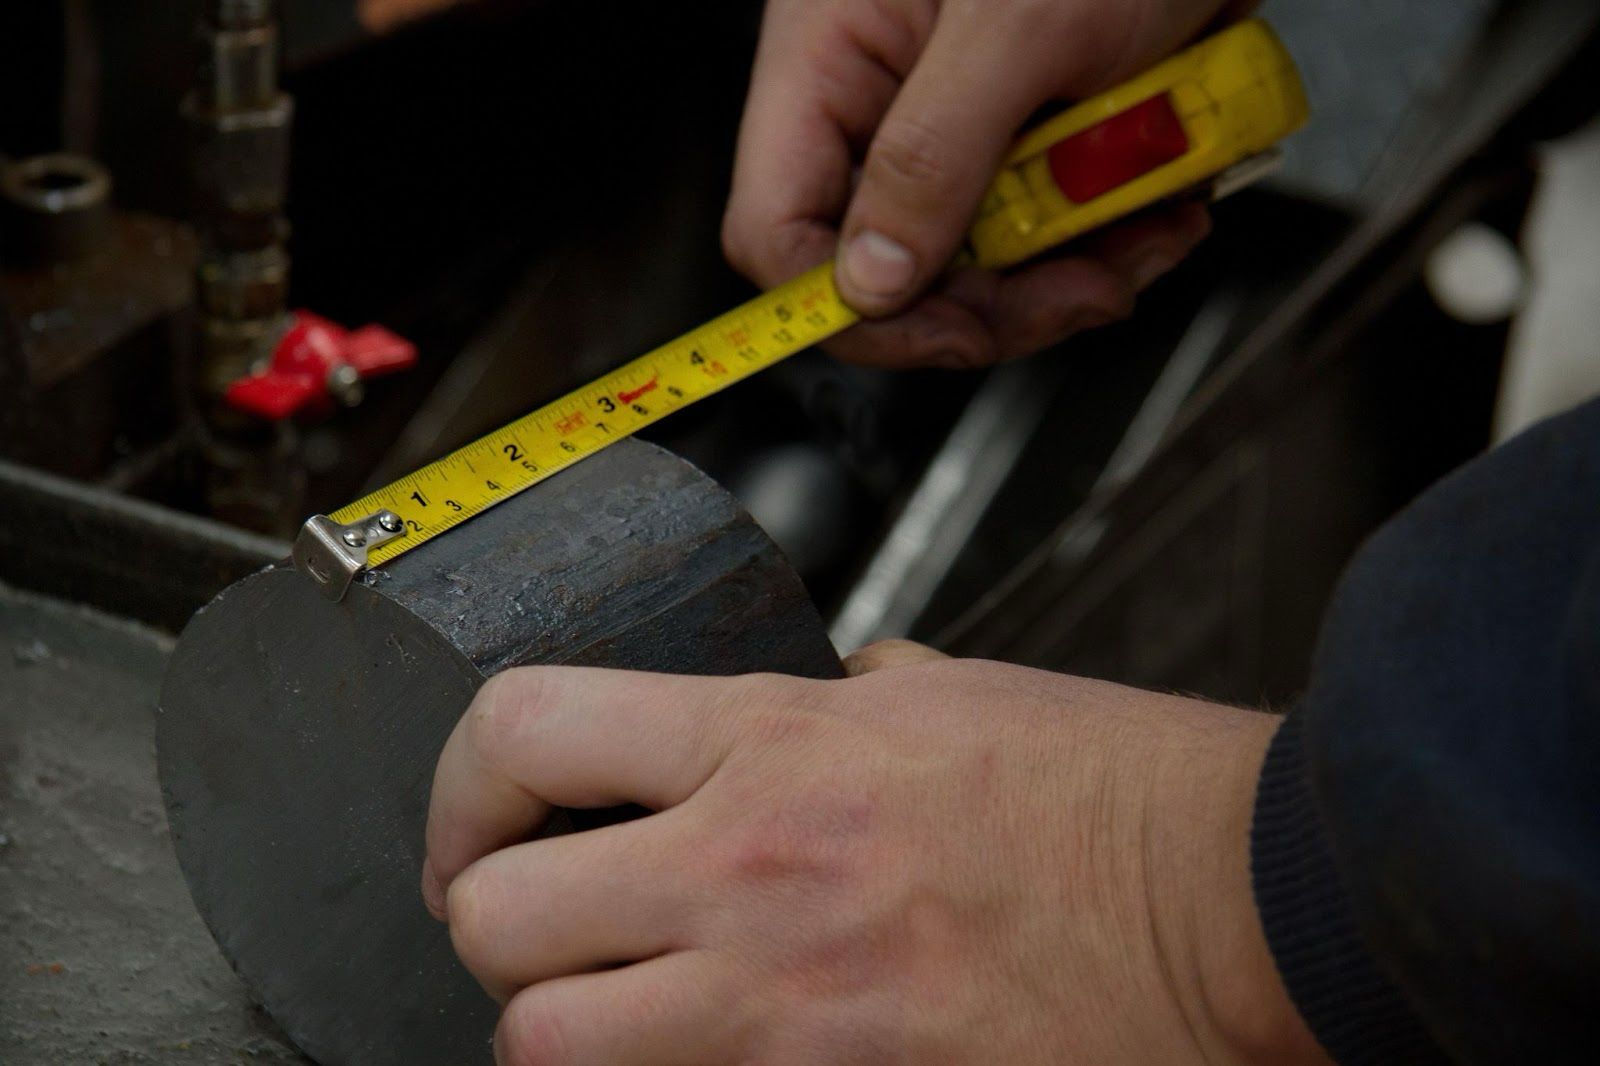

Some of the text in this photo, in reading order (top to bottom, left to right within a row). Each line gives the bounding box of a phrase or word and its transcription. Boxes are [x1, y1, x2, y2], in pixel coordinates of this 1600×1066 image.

[407, 519, 424, 533] 2
[446, 500, 462, 512] 3
[486, 480, 501, 492] 4
[522, 460, 537, 473] 5
[560, 441, 575, 453] 6
[595, 422, 610, 434] 7
[631, 404, 648, 417] 8
[702, 359, 728, 378] 10
[411, 491, 427, 507] 1
[504, 444, 523, 462] 2
[597, 396, 616, 413] 3
[690, 351, 706, 366] 4
